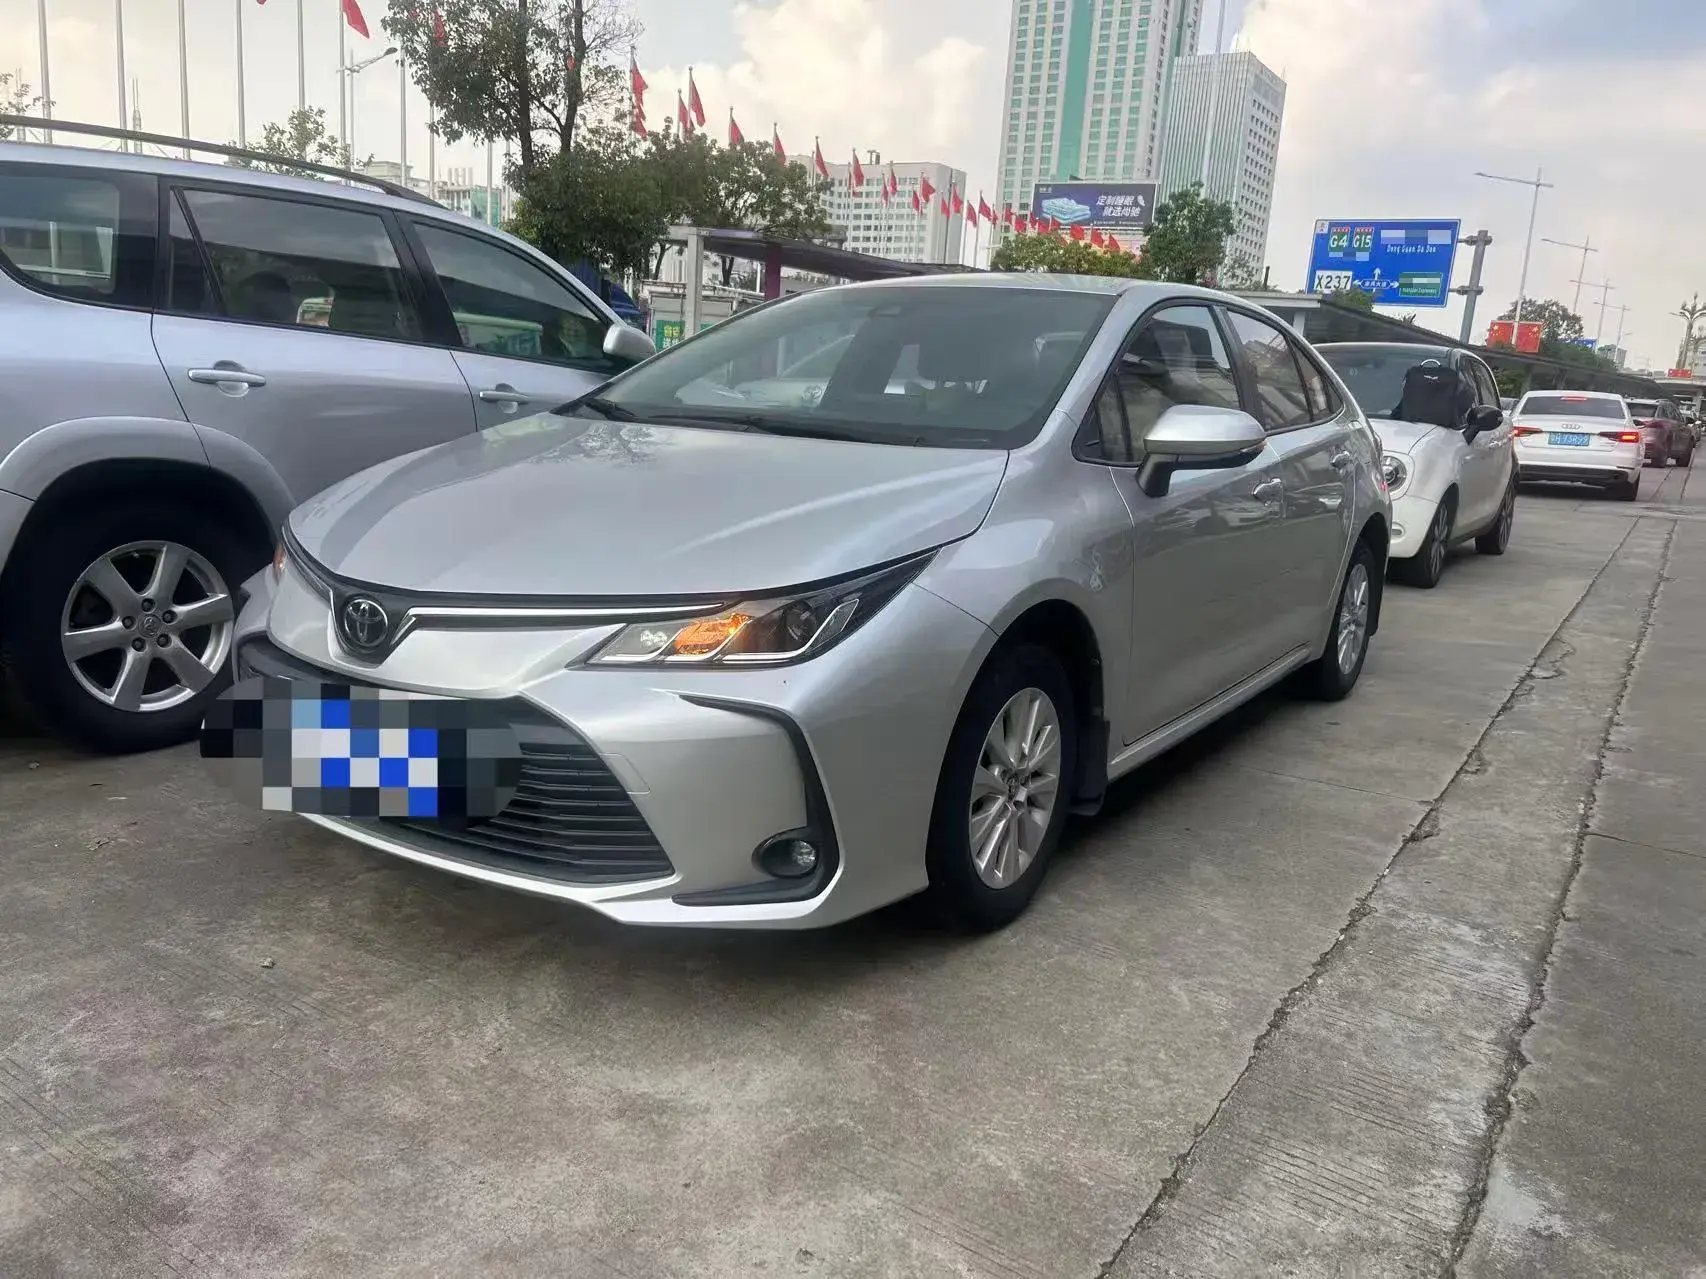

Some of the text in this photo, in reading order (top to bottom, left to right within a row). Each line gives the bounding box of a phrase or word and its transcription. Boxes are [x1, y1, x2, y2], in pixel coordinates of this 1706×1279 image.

[1096, 195, 1135, 206] 定制睡眠
[1330, 234, 1348, 248] G4
[1353, 234, 1371, 248] G15
[1316, 274, 1352, 290] X237
